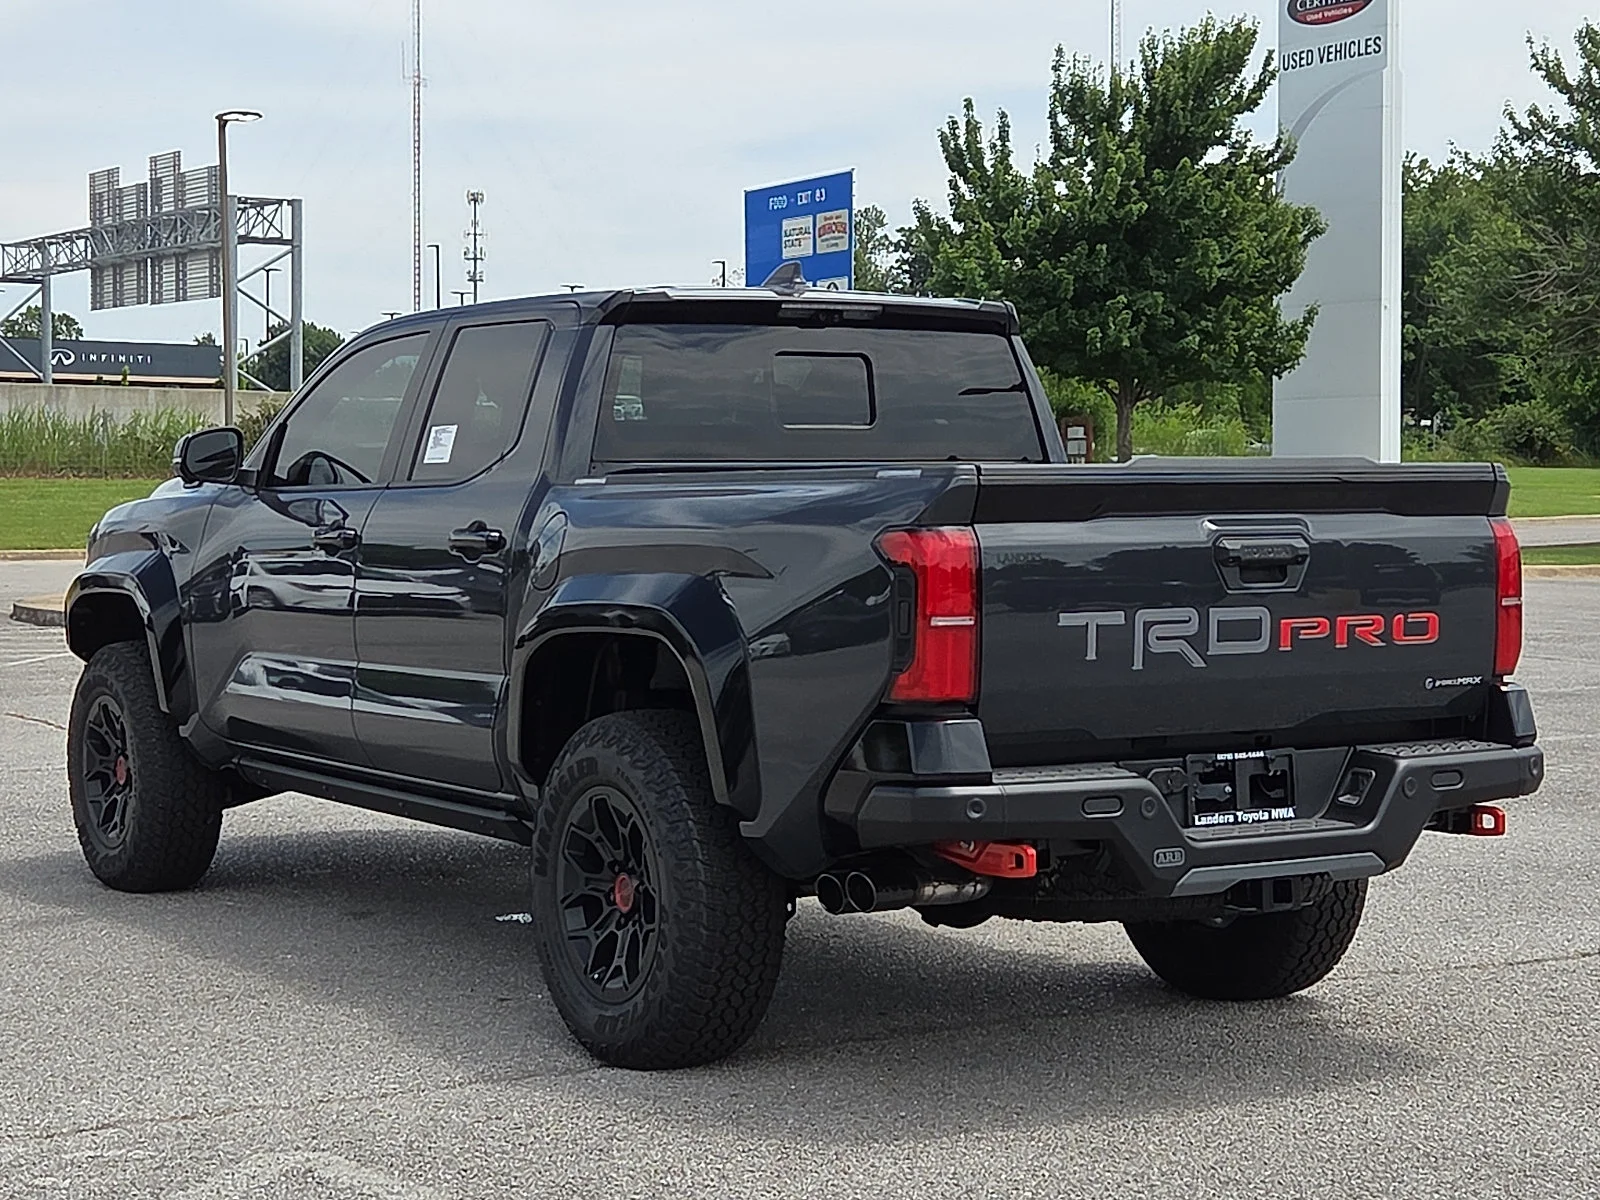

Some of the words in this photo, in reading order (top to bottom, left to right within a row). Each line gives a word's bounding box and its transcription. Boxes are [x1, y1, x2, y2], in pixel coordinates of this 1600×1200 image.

[1324, 7, 1353, 18] Vehicles
[1282, 49, 1314, 71] USED
[1317, 36, 1382, 64] VEHICLES
[797, 191, 812, 205] EXIT
[81, 353, 151, 364] INFINITI
[1057, 606, 1272, 671] TRD
[1278, 611, 1440, 651] PRO
[1194, 812, 1234, 825] Landers
[1236, 810, 1269, 823] Toyota
[1271, 807, 1295, 819] NWA
[1157, 851, 1182, 864] ARB
